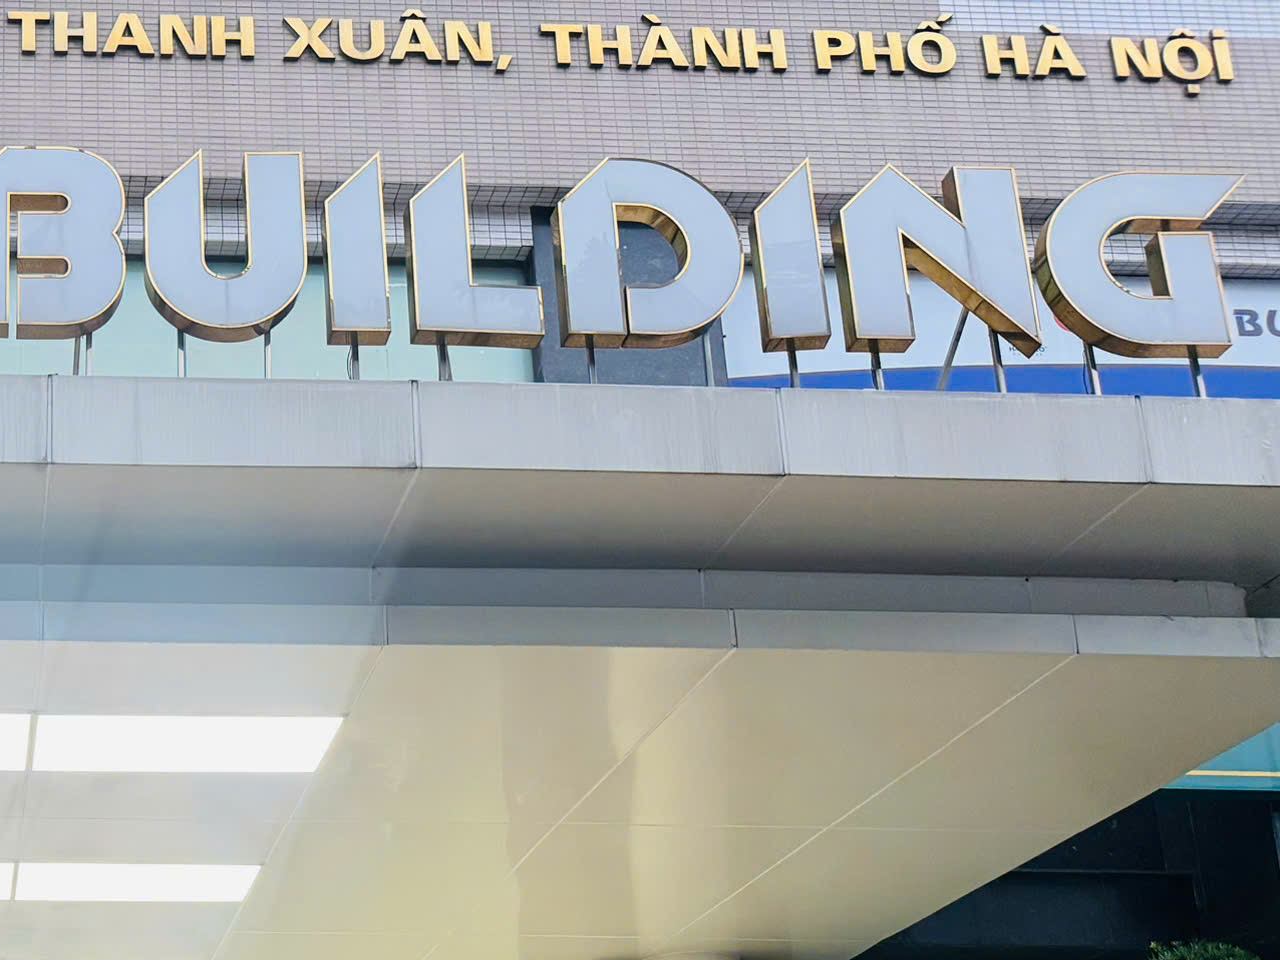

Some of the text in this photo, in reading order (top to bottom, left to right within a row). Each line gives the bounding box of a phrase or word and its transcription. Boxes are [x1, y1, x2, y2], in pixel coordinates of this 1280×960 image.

[7, 13, 256, 61] THANH
[283, 9, 513, 73] XUÂN,
[540, 14, 788, 72] THÀNH
[813, 15, 957, 76] PHỐ
[983, 24, 1087, 80] HÀ
[1111, 28, 1234, 96] NỘI
